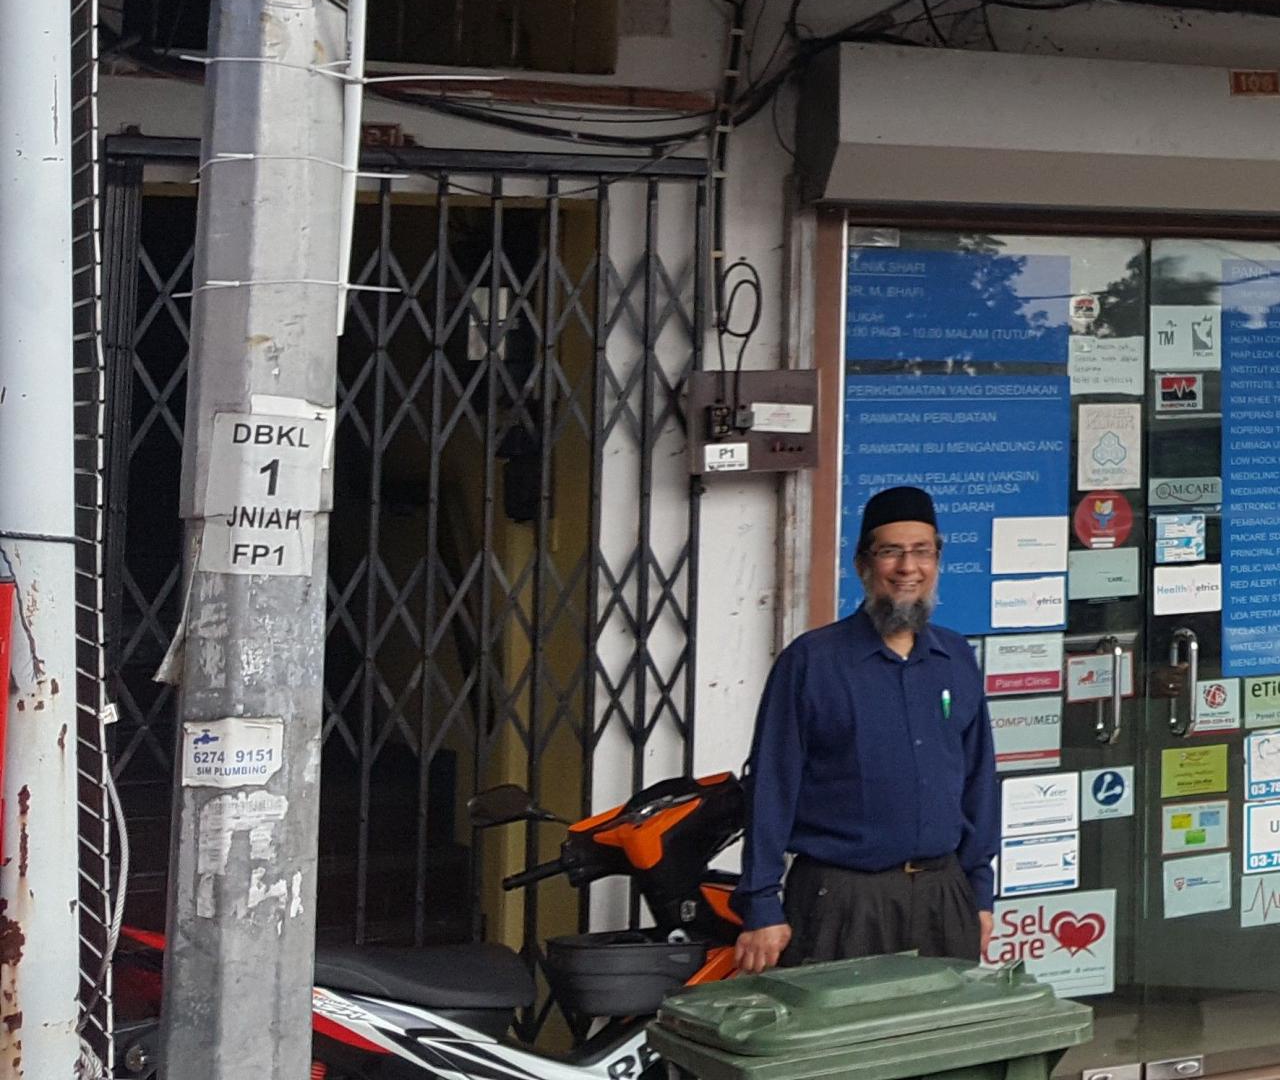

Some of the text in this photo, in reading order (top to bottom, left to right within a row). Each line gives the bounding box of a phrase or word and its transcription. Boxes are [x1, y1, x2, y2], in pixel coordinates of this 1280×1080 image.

[1158, 331, 1174, 345] TM
[848, 385, 1059, 396] PERKHIDMATAN YANG DISEDIAKAN
[1230, 396, 1246, 404] KIM
[860, 412, 997, 423] RAWATAN PERUBATAN
[232, 423, 311, 449] DBKL
[859, 441, 1063, 453] RAWATAN IBU MENGANDUNG ANC
[719, 448, 735, 459] P1
[259, 458, 280, 497] 1
[859, 474, 925, 485] SUNTIKAN
[927, 472, 985, 483] PELALIAN
[967, 484, 1020, 495] DEWASA
[952, 502, 995, 513] DARAH
[1230, 502, 1276, 511] METRONIC
[226, 505, 302, 531] JNIAH
[952, 533, 978, 544] ECG
[1230, 533, 1266, 542] PMCARE
[231, 544, 286, 567] FP1
[1230, 548, 1274, 557] PRINCIPAL
[952, 563, 983, 573] KECIL
[1230, 564, 1261, 573] PUBLIC
[1230, 580, 1248, 589] RED
[1250, 579, 1277, 588] ALERT
[1230, 596, 1248, 605] THE
[1250, 595, 1270, 604] NEW
[1024, 677, 1051, 687] Clinic
[193, 748, 275, 765] 6274 9151
[214, 765, 268, 776] PLUMBING
[982, 936, 1045, 965] Care
